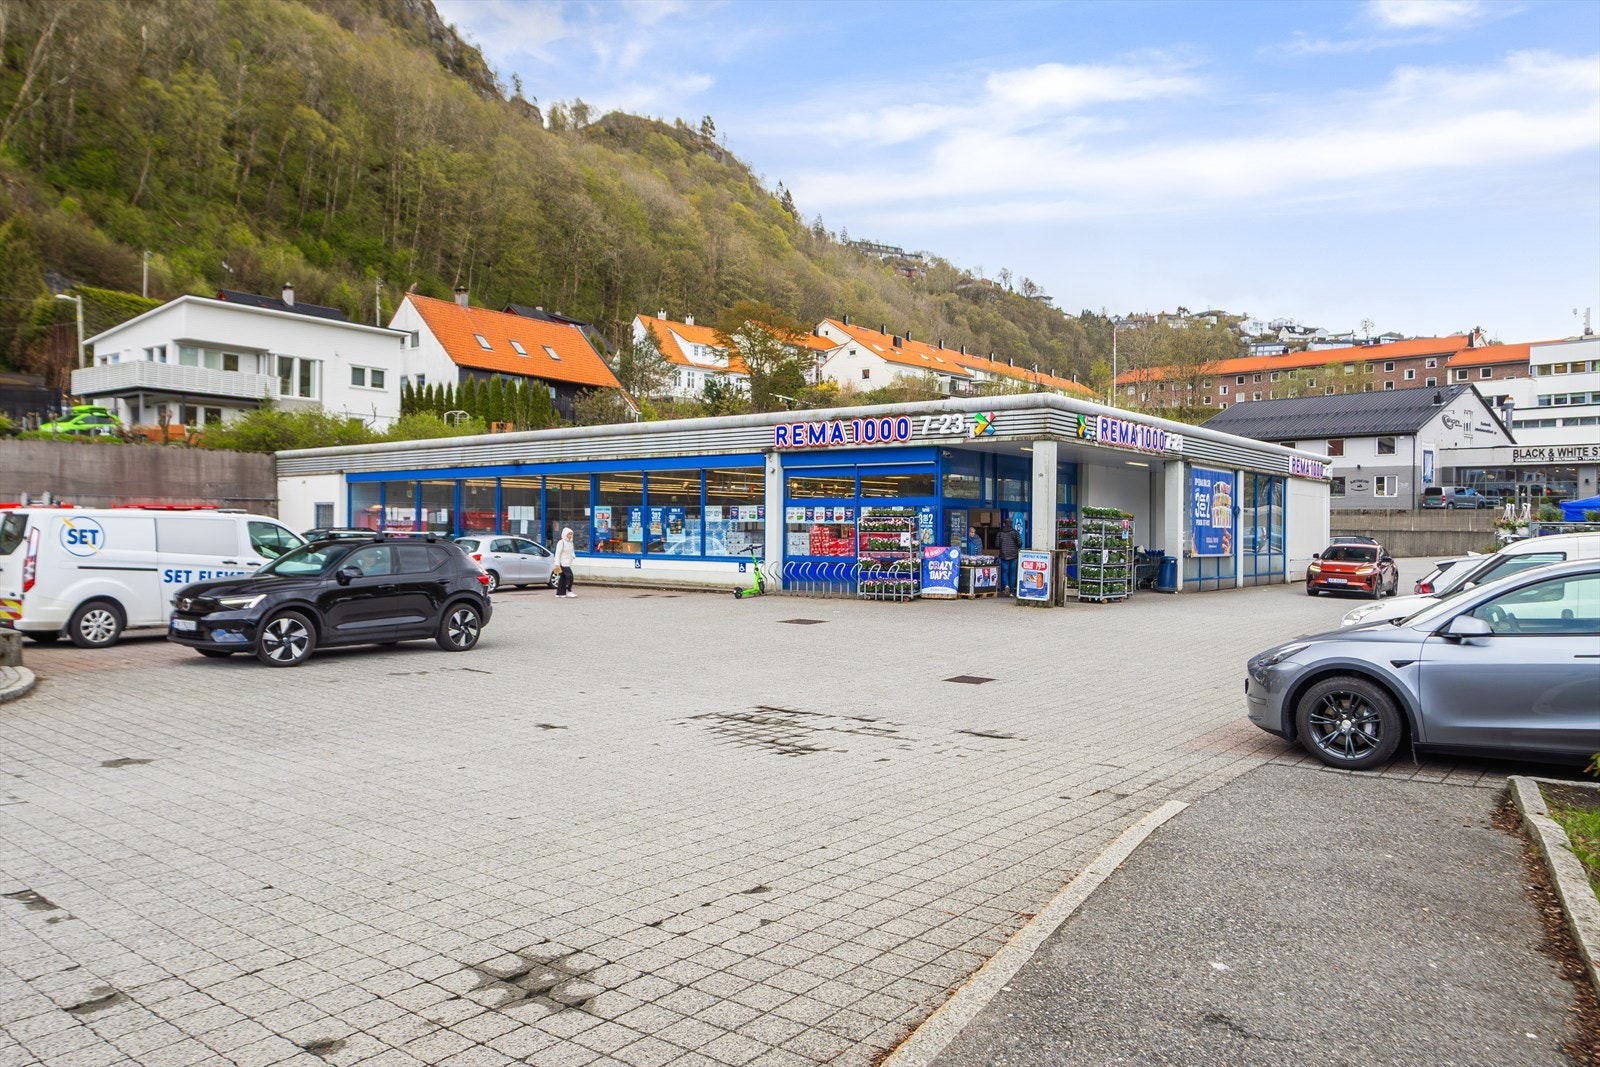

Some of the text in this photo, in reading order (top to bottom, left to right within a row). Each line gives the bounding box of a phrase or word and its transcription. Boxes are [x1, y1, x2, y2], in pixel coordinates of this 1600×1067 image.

[774, 416, 913, 448] REMA 1000
[920, 413, 965, 435] 7-23
[1099, 417, 1165, 452] REMA 1000
[1513, 446, 1600, 459] BLACK & WHITE S
[1291, 457, 1310, 475] REMA
[1310, 461, 1324, 478] 1000
[1194, 491, 1200, 518] 3
[1206, 493, 1211, 519] 2
[928, 513, 934, 525] 2
[67, 528, 99, 545] SET
[928, 560, 954, 570] CRAZY
[163, 569, 192, 584] SET
[929, 570, 952, 580] DAYS!
